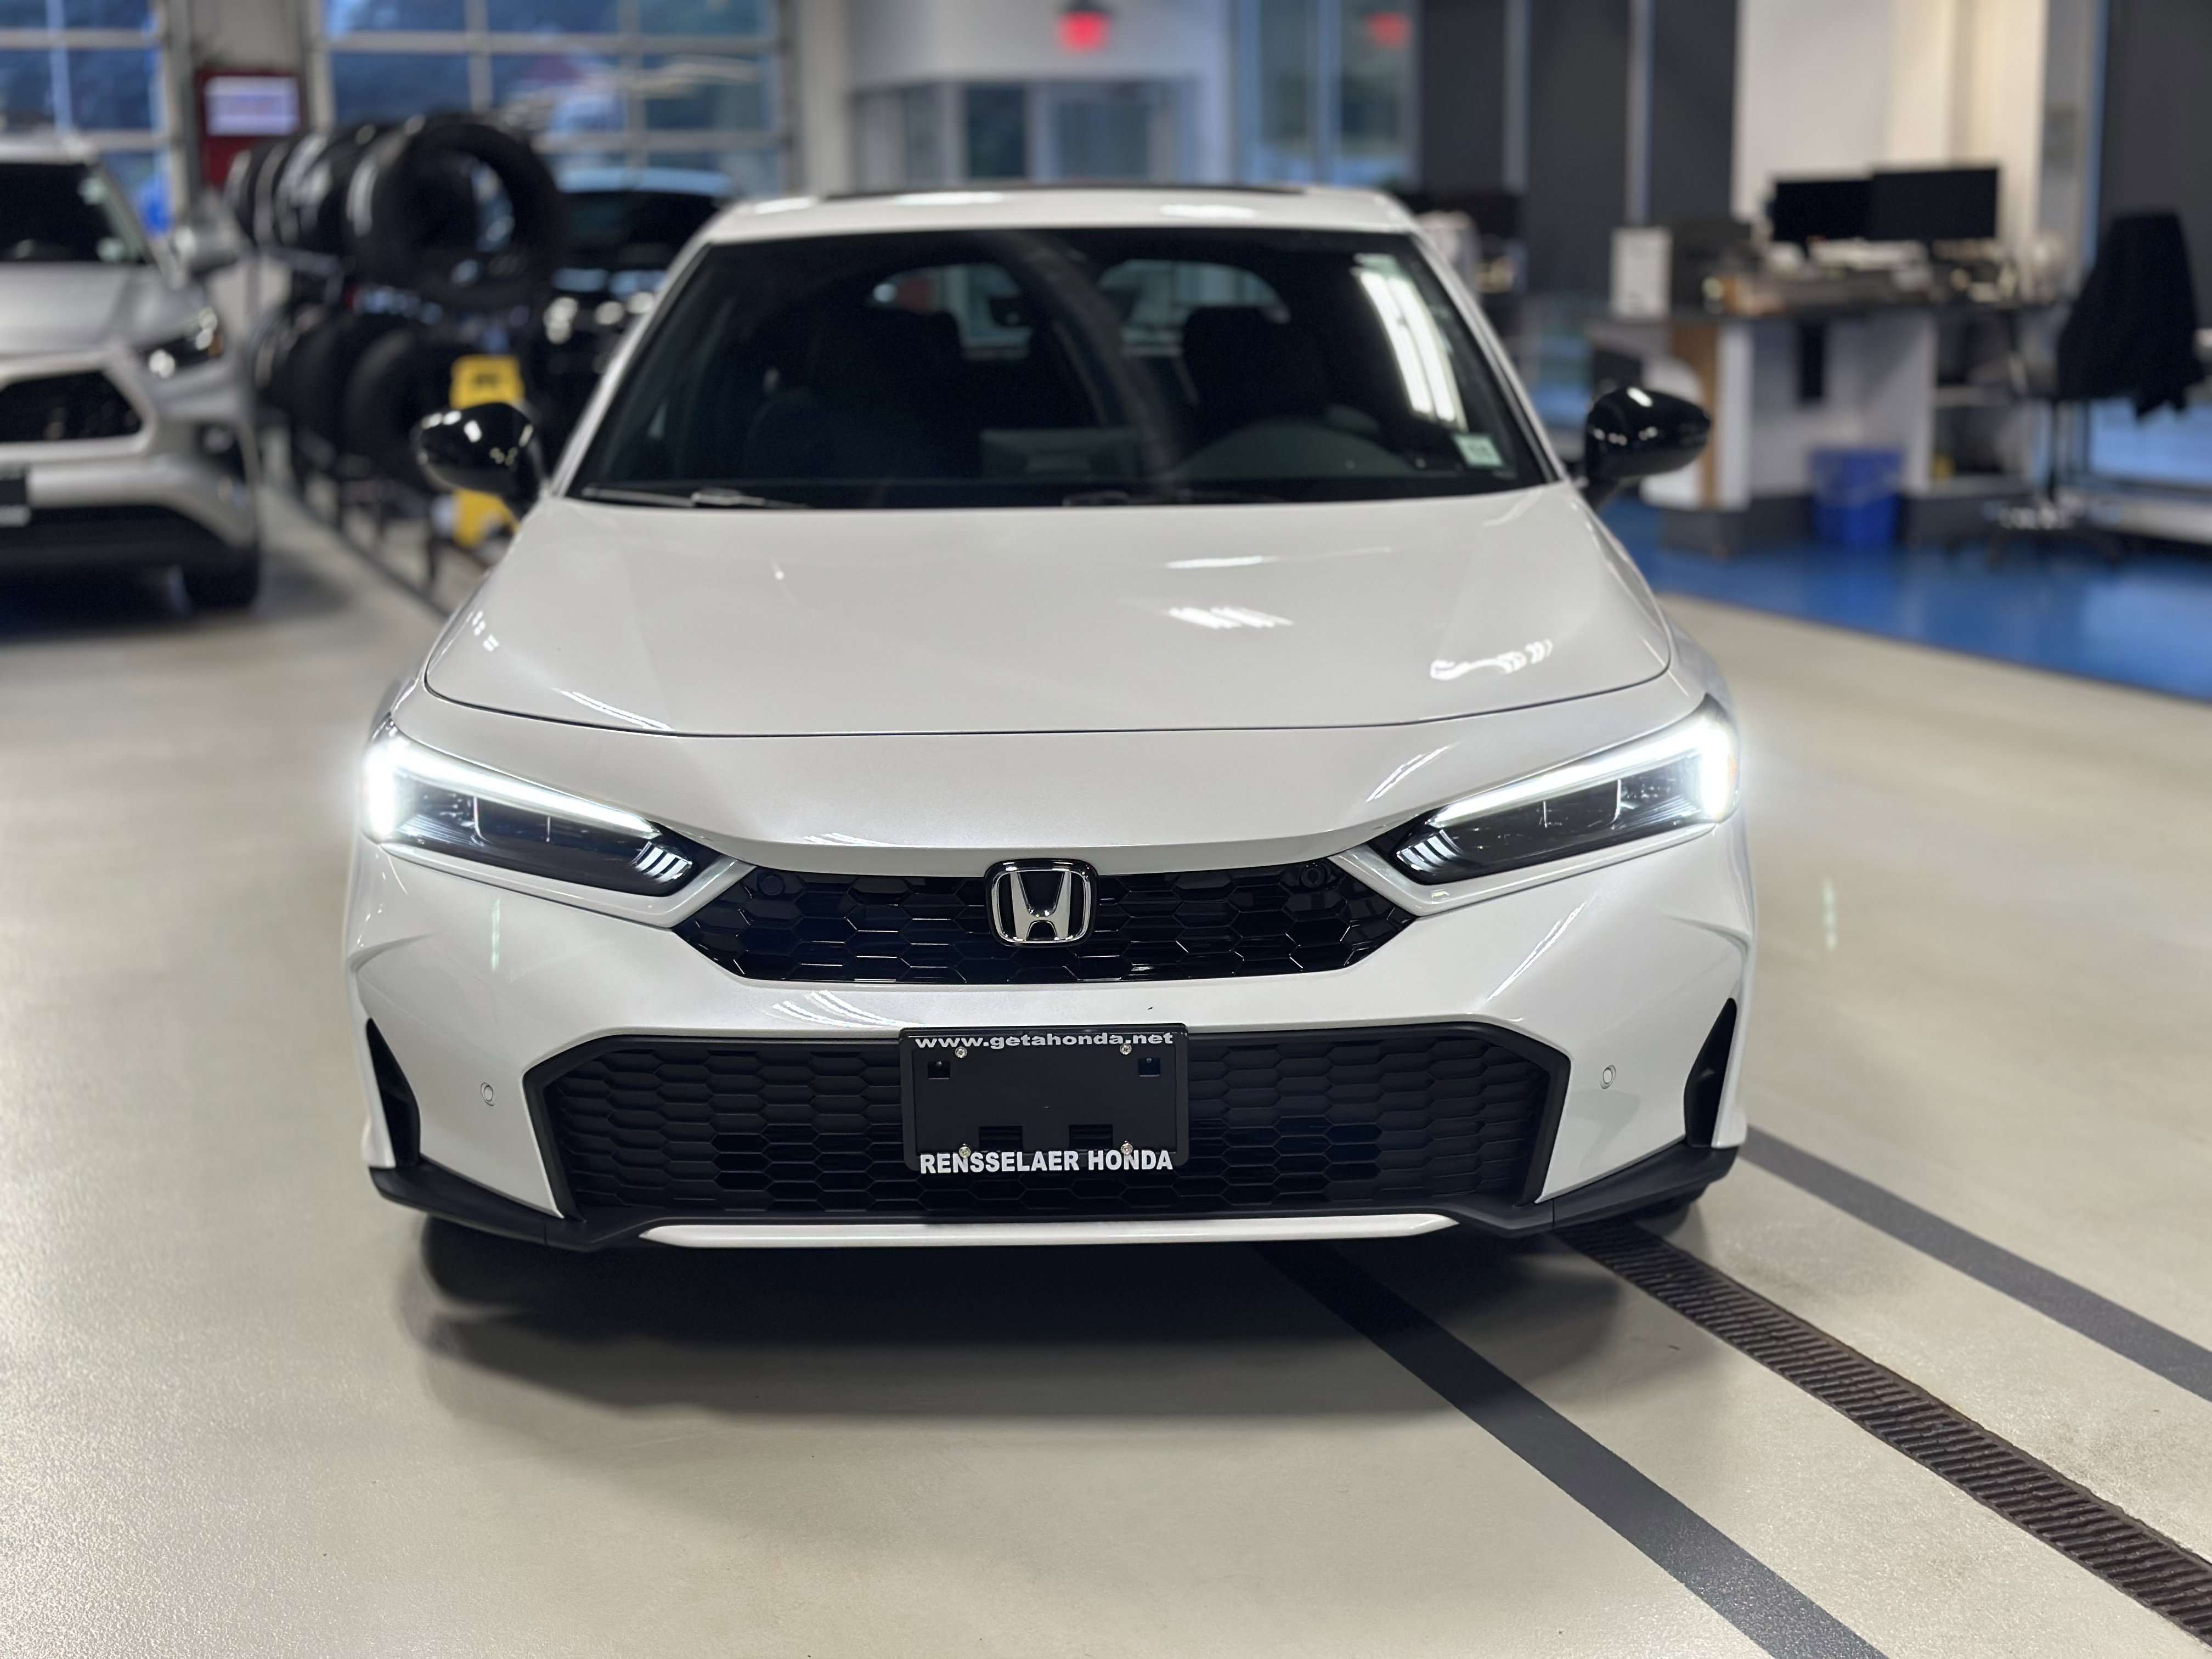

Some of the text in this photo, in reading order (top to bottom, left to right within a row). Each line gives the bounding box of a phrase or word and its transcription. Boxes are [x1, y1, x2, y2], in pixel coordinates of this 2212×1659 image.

[915, 1032, 1173, 1049] www.getahonda.net
[921, 1150, 1173, 1173] RENSSELAER HONDA
